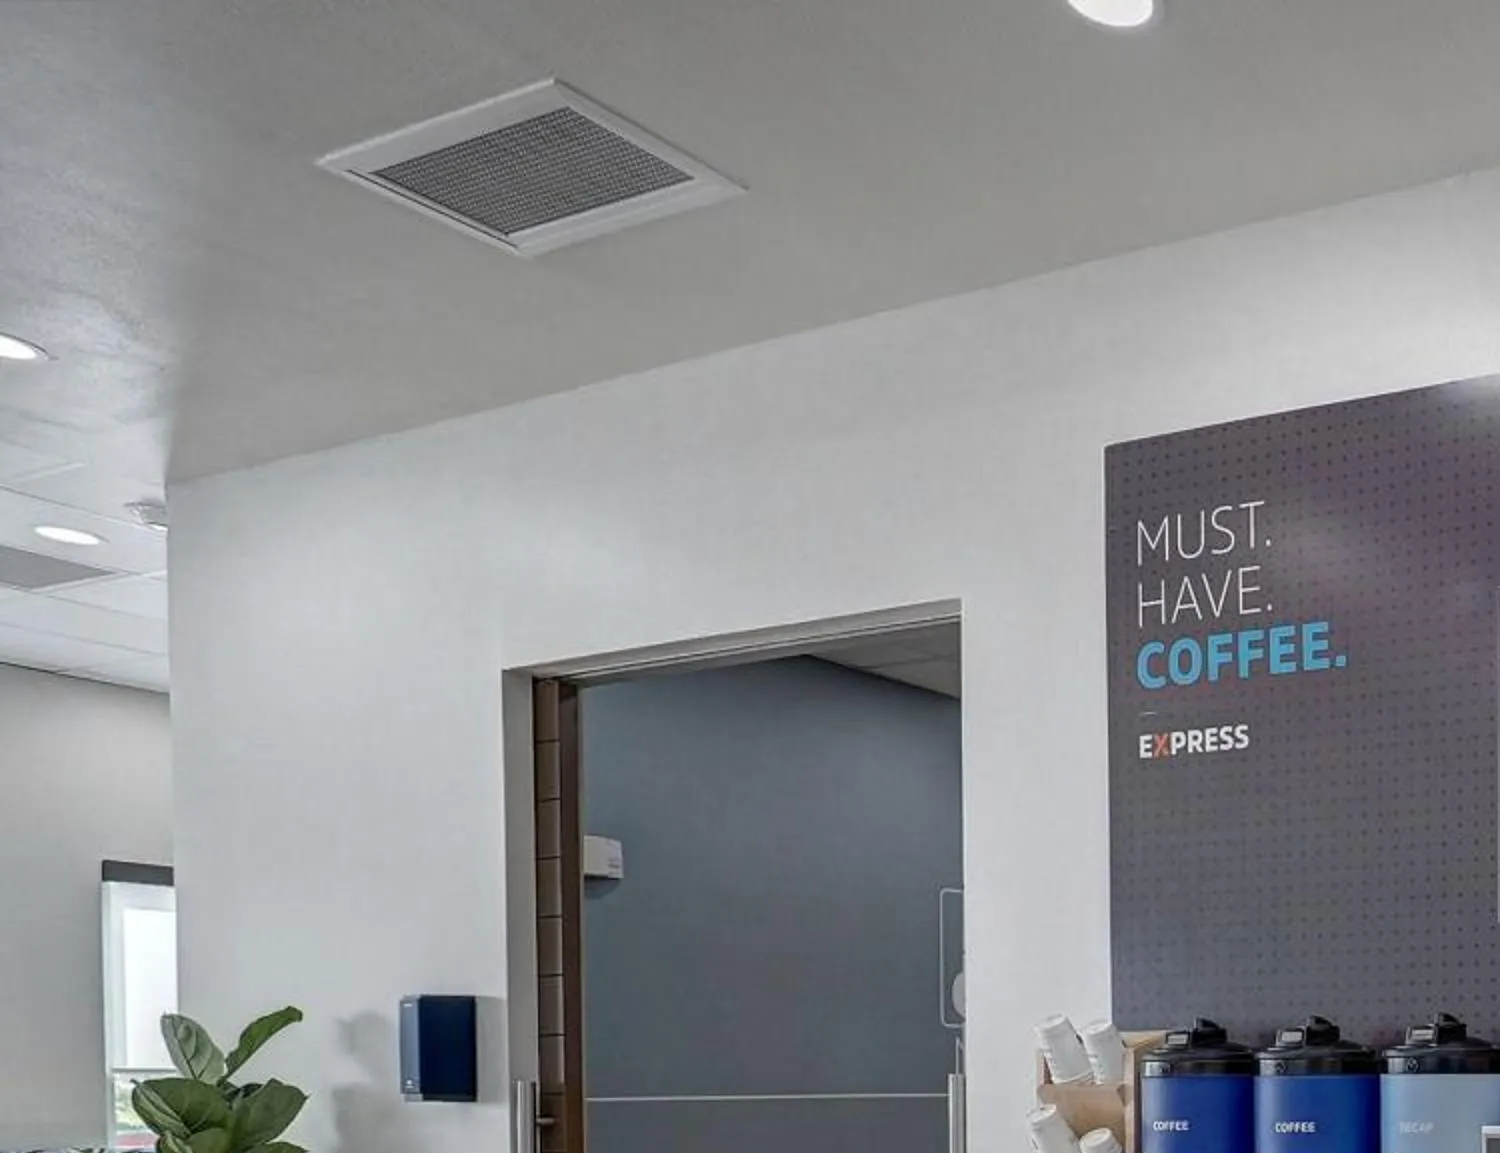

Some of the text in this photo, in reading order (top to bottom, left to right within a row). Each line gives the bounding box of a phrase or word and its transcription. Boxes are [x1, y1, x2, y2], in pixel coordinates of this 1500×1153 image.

[1137, 500, 1272, 566] MUST.
[1138, 565, 1273, 628] HAVE.
[1136, 621, 1347, 689] COFFEE.
[1138, 724, 1250, 759] EXPRESS
[1153, 1120, 1190, 1131] COFFEE
[1275, 1121, 1317, 1133] COFFEE
